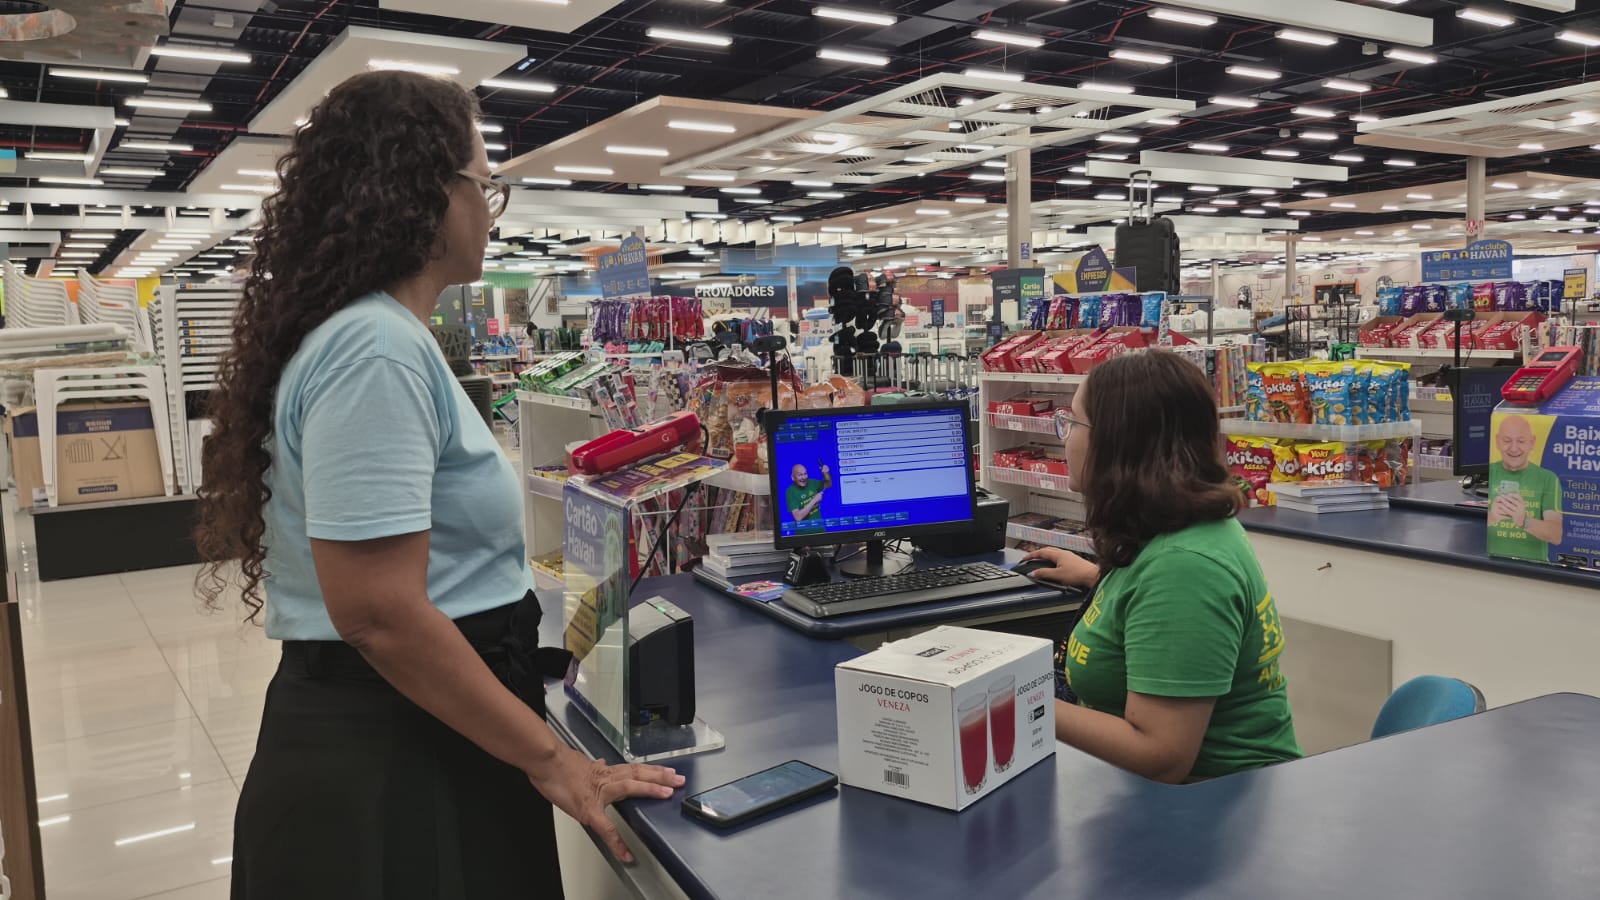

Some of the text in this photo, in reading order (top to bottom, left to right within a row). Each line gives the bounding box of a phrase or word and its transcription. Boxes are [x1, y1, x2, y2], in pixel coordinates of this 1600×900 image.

[1485, 242, 1507, 250] clube
[1470, 249, 1507, 260] HAVAN
[695, 285, 775, 298] PROVADORES
[1566, 479, 1597, 491] Tenha
[1563, 491, 1576, 499] na
[1572, 502, 1591, 510] sua
[566, 496, 597, 537] Cartão
[567, 525, 595, 568] Havan
[788, 561, 795, 575] 2
[1016, 671, 1054, 697] JOGO DE COPOS
[858, 683, 929, 703] JOGO DE COPOS
[1027, 691, 1045, 705] VENEZA
[877, 698, 911, 712] VENEZA
